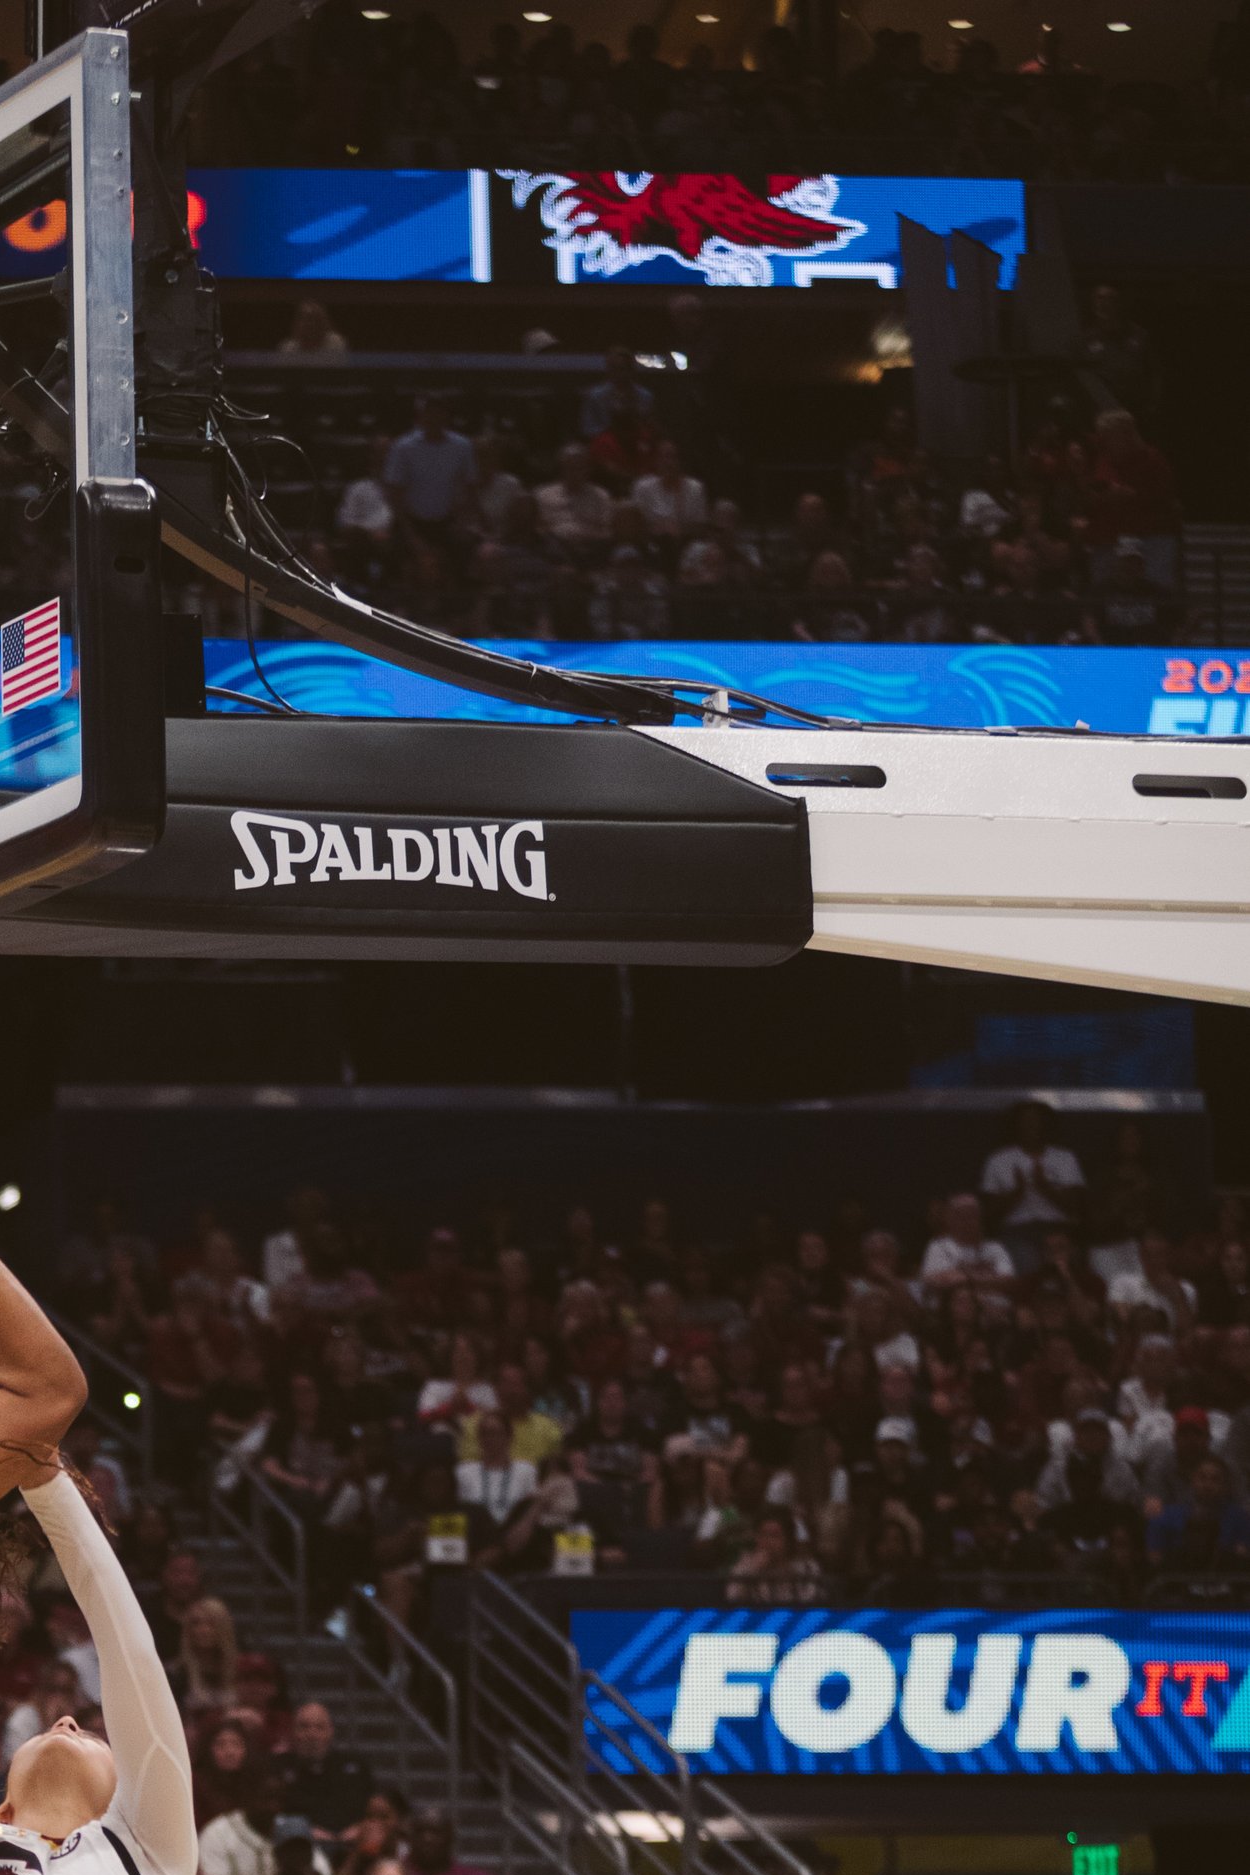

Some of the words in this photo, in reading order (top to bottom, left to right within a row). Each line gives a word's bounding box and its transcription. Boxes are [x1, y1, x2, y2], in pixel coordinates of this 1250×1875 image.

[230, 810, 550, 901] SPALDING
[667, 1630, 1131, 1753] FOUR
[1135, 1660, 1230, 1716] IT
